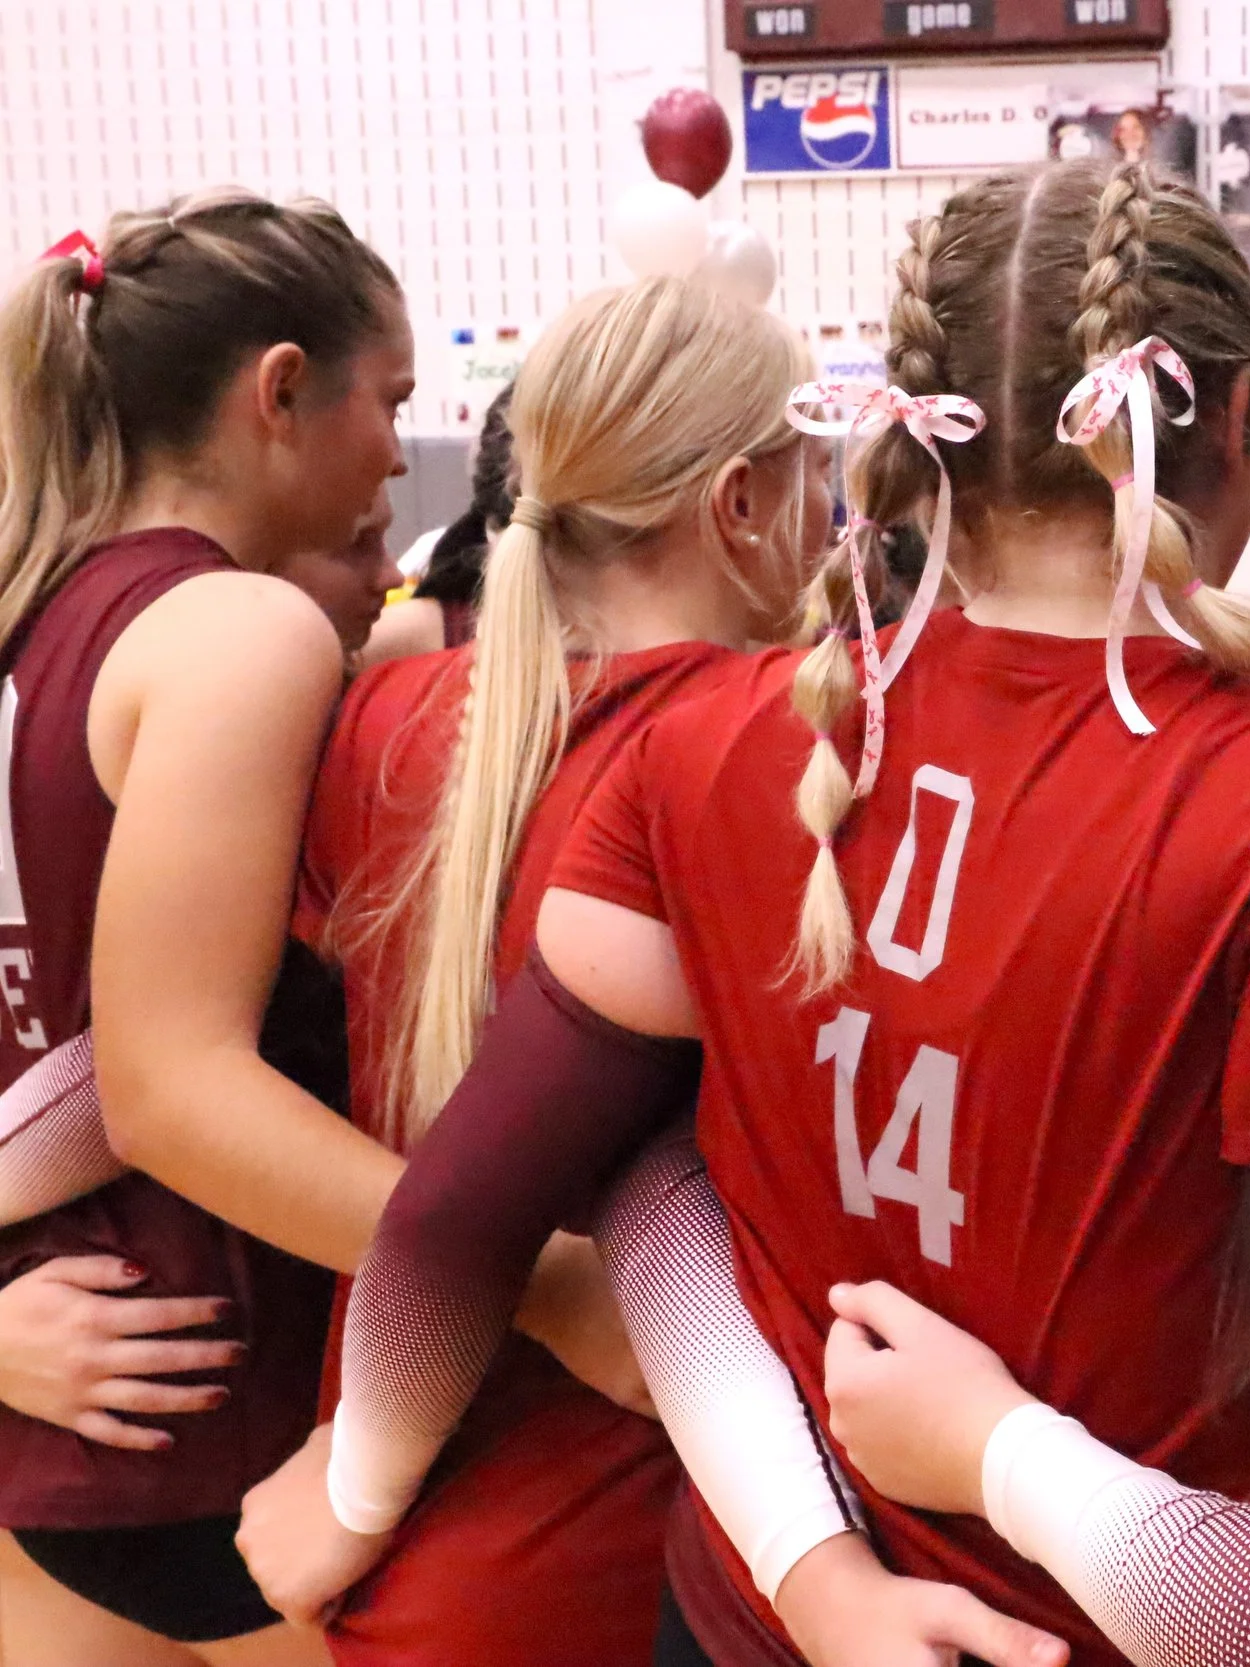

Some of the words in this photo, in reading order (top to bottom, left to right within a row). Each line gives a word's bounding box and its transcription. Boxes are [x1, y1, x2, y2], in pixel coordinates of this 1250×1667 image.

[755, 9, 806, 35] won
[907, 3, 972, 36] game
[1074, 0, 1127, 24] won
[751, 70, 881, 111] PEPSI
[909, 107, 992, 125] Charles
[814, 1005, 965, 1268] 14
